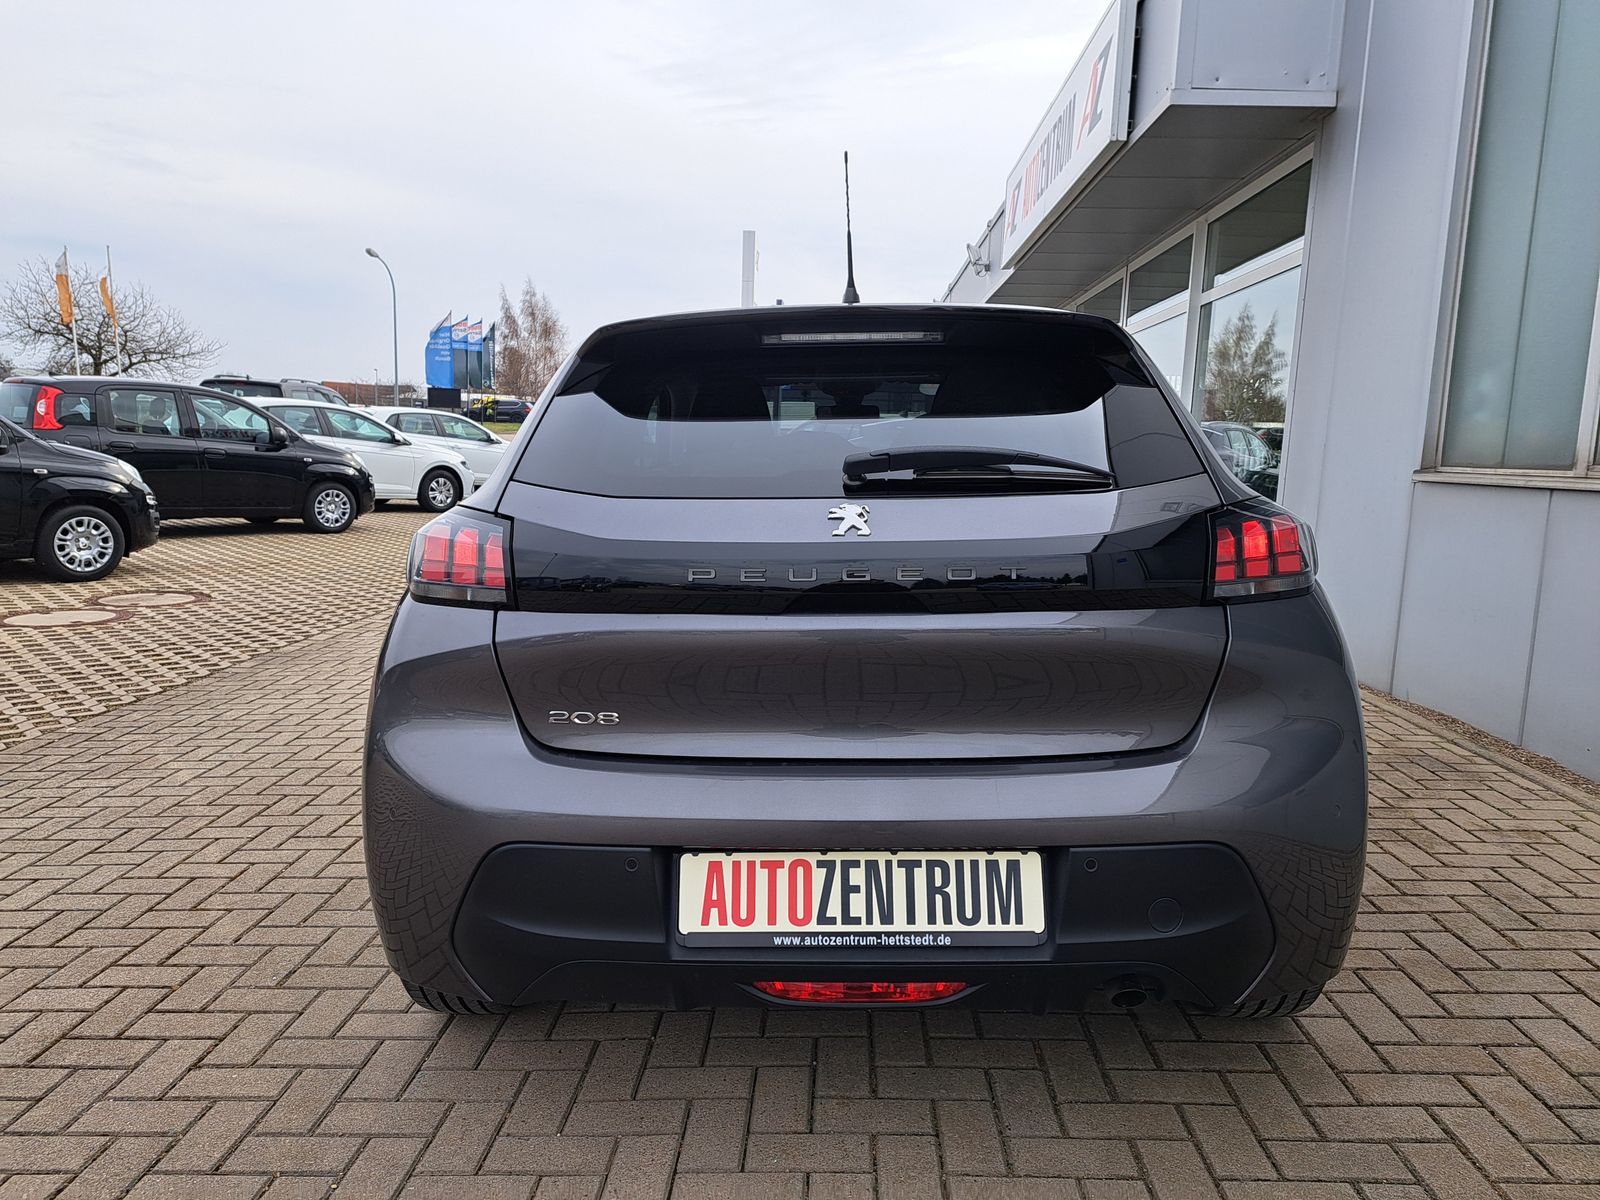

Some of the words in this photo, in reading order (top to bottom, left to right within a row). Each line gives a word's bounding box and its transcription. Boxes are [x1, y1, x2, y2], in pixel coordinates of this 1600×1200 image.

[1021, 91, 1077, 222] AUTOZENTRUM
[687, 566, 1027, 582] PEUGEOT
[549, 710, 620, 725] 208
[700, 858, 1024, 927] AUTOZENTRUM
[773, 933, 952, 947] www.autozentrum-hettstedt.de
